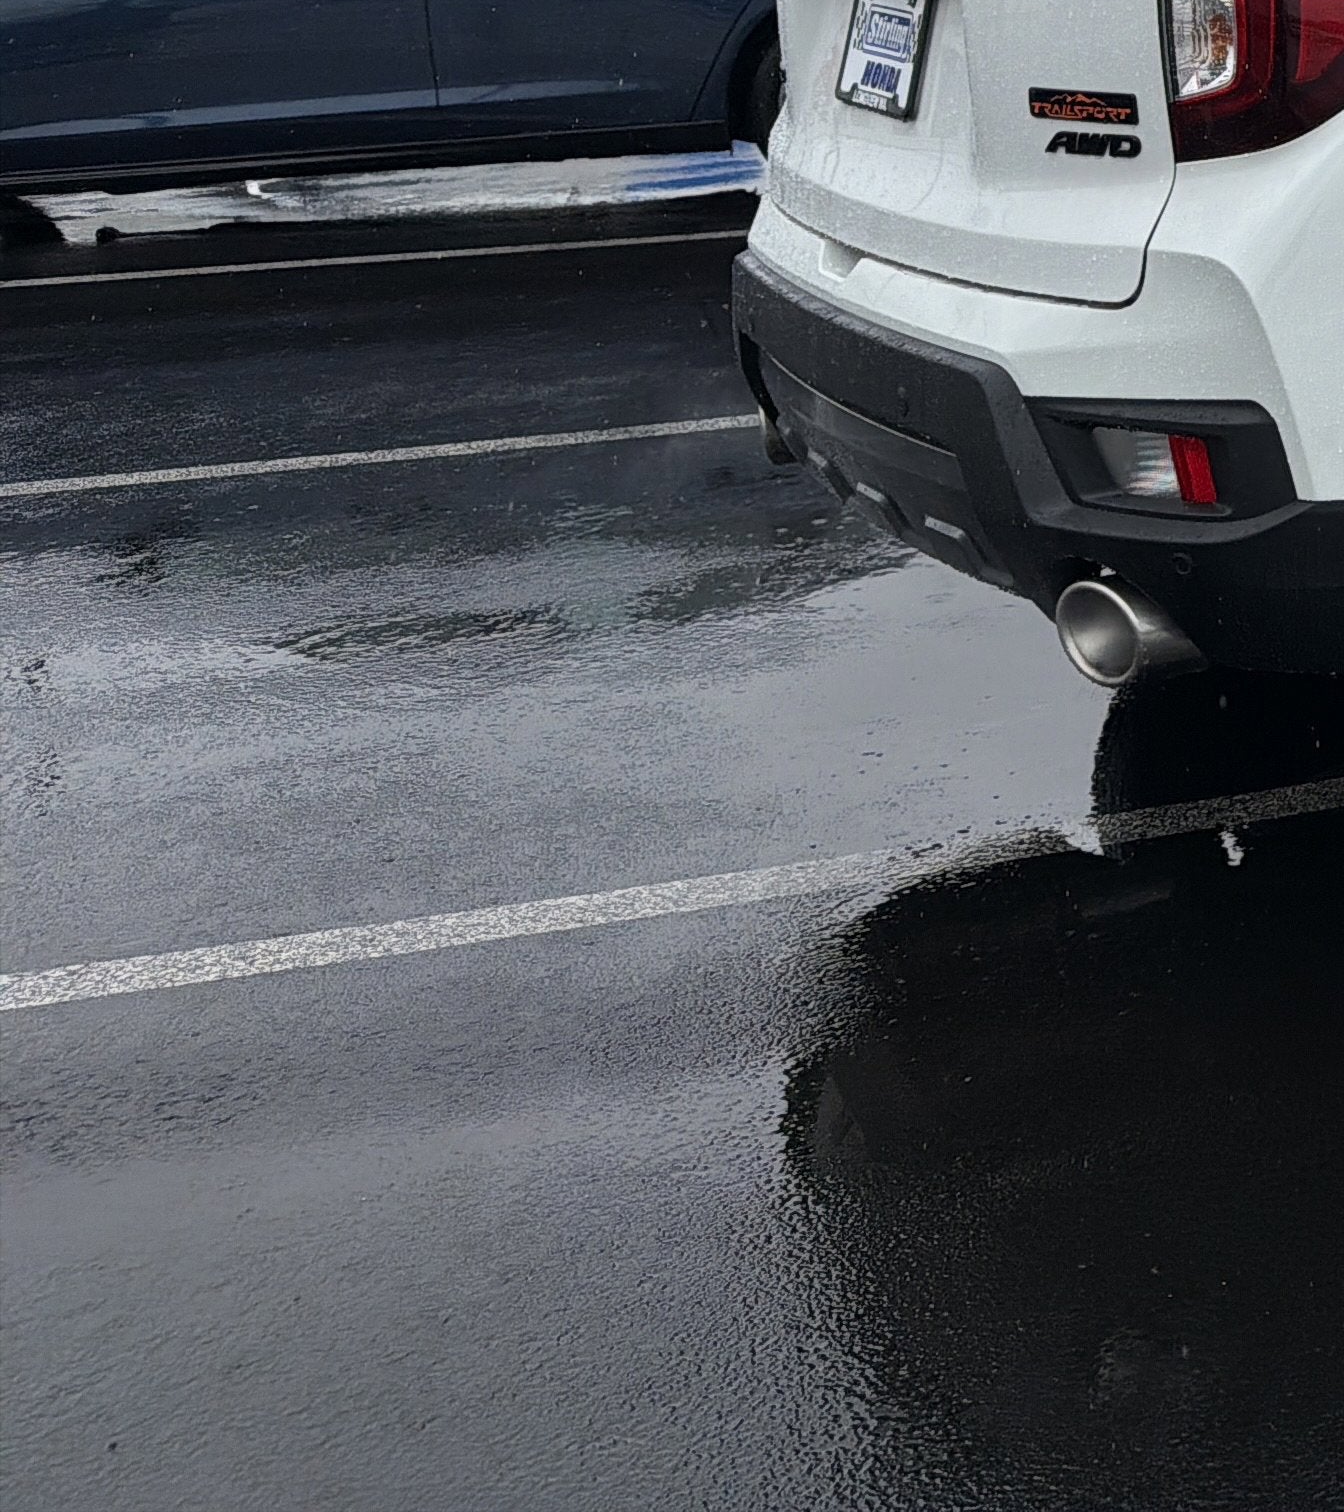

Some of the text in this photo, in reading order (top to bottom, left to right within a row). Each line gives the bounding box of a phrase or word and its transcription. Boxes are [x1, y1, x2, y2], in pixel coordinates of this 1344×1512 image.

[866, 13, 911, 59] Stirling
[860, 60, 902, 93] HONDA
[1031, 101, 1131, 122] TRAILSPORT
[1045, 131, 1142, 158] AWD
